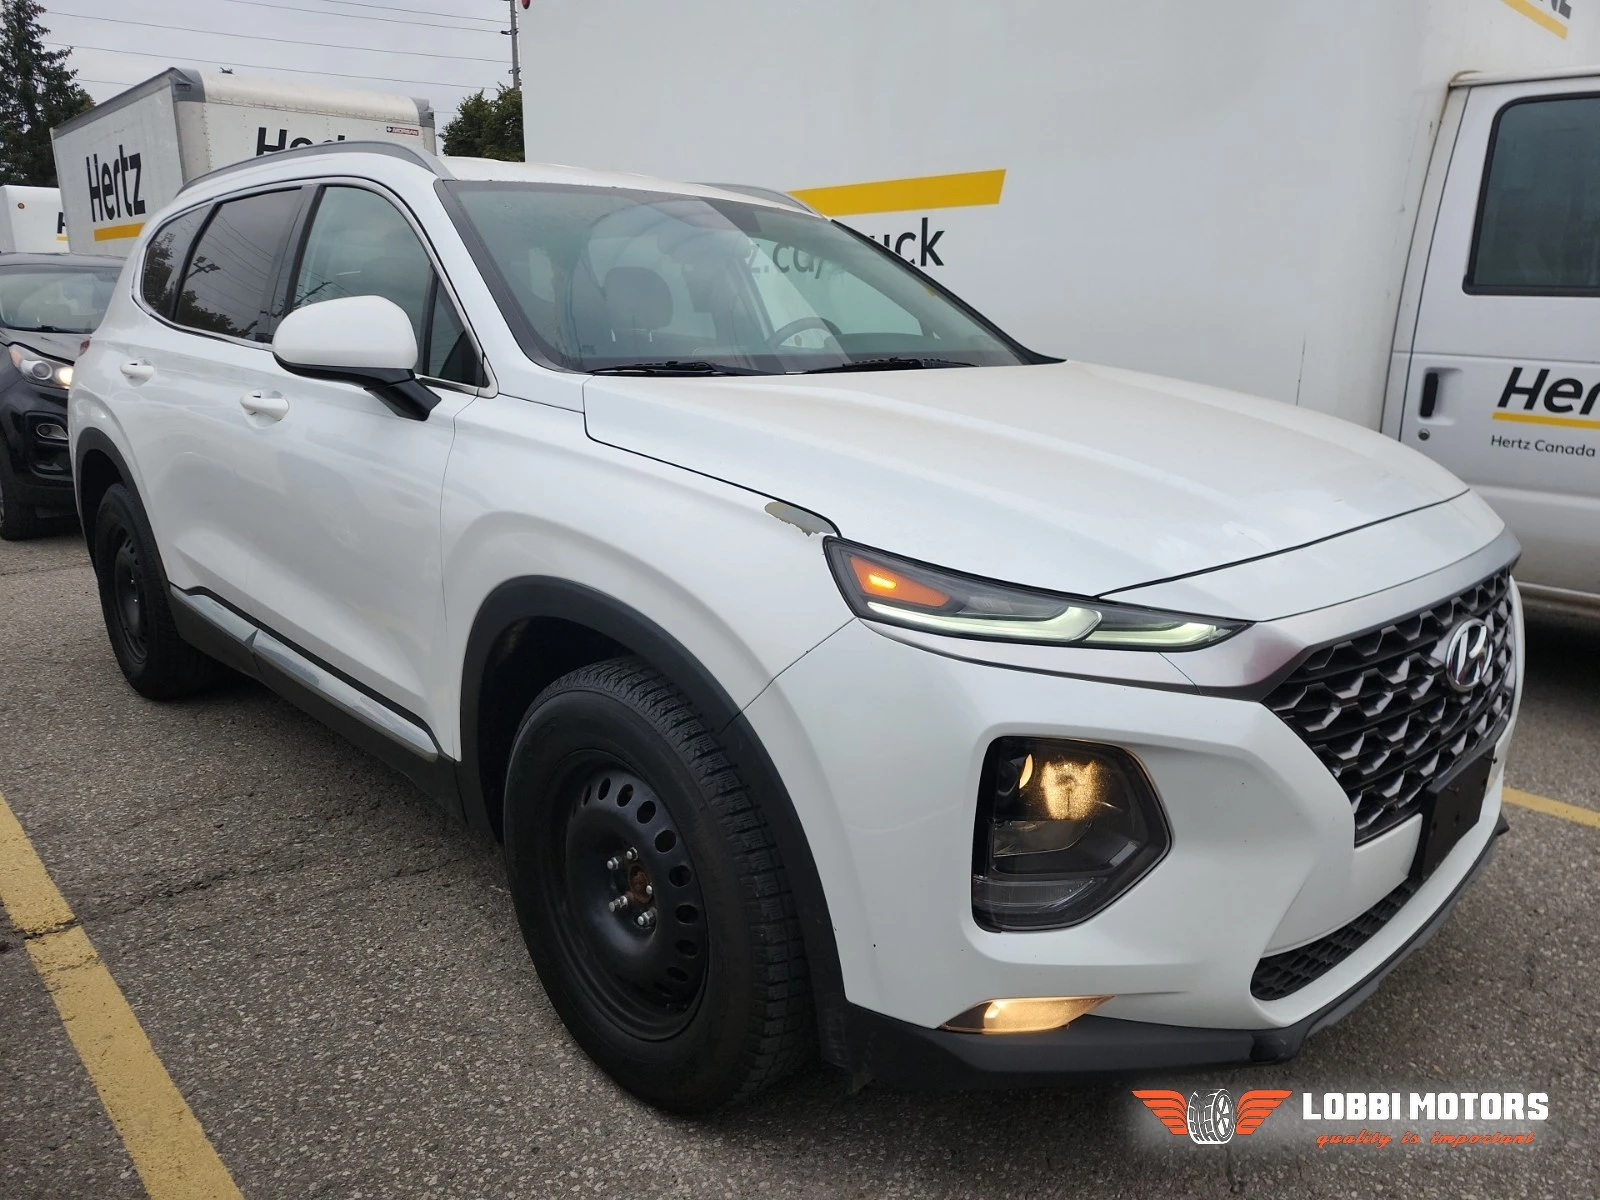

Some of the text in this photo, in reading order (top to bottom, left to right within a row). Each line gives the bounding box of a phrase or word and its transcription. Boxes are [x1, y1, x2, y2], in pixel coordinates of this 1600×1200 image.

[86, 144, 146, 222] Hertz
[1491, 434, 1596, 457] Hertz Canada
